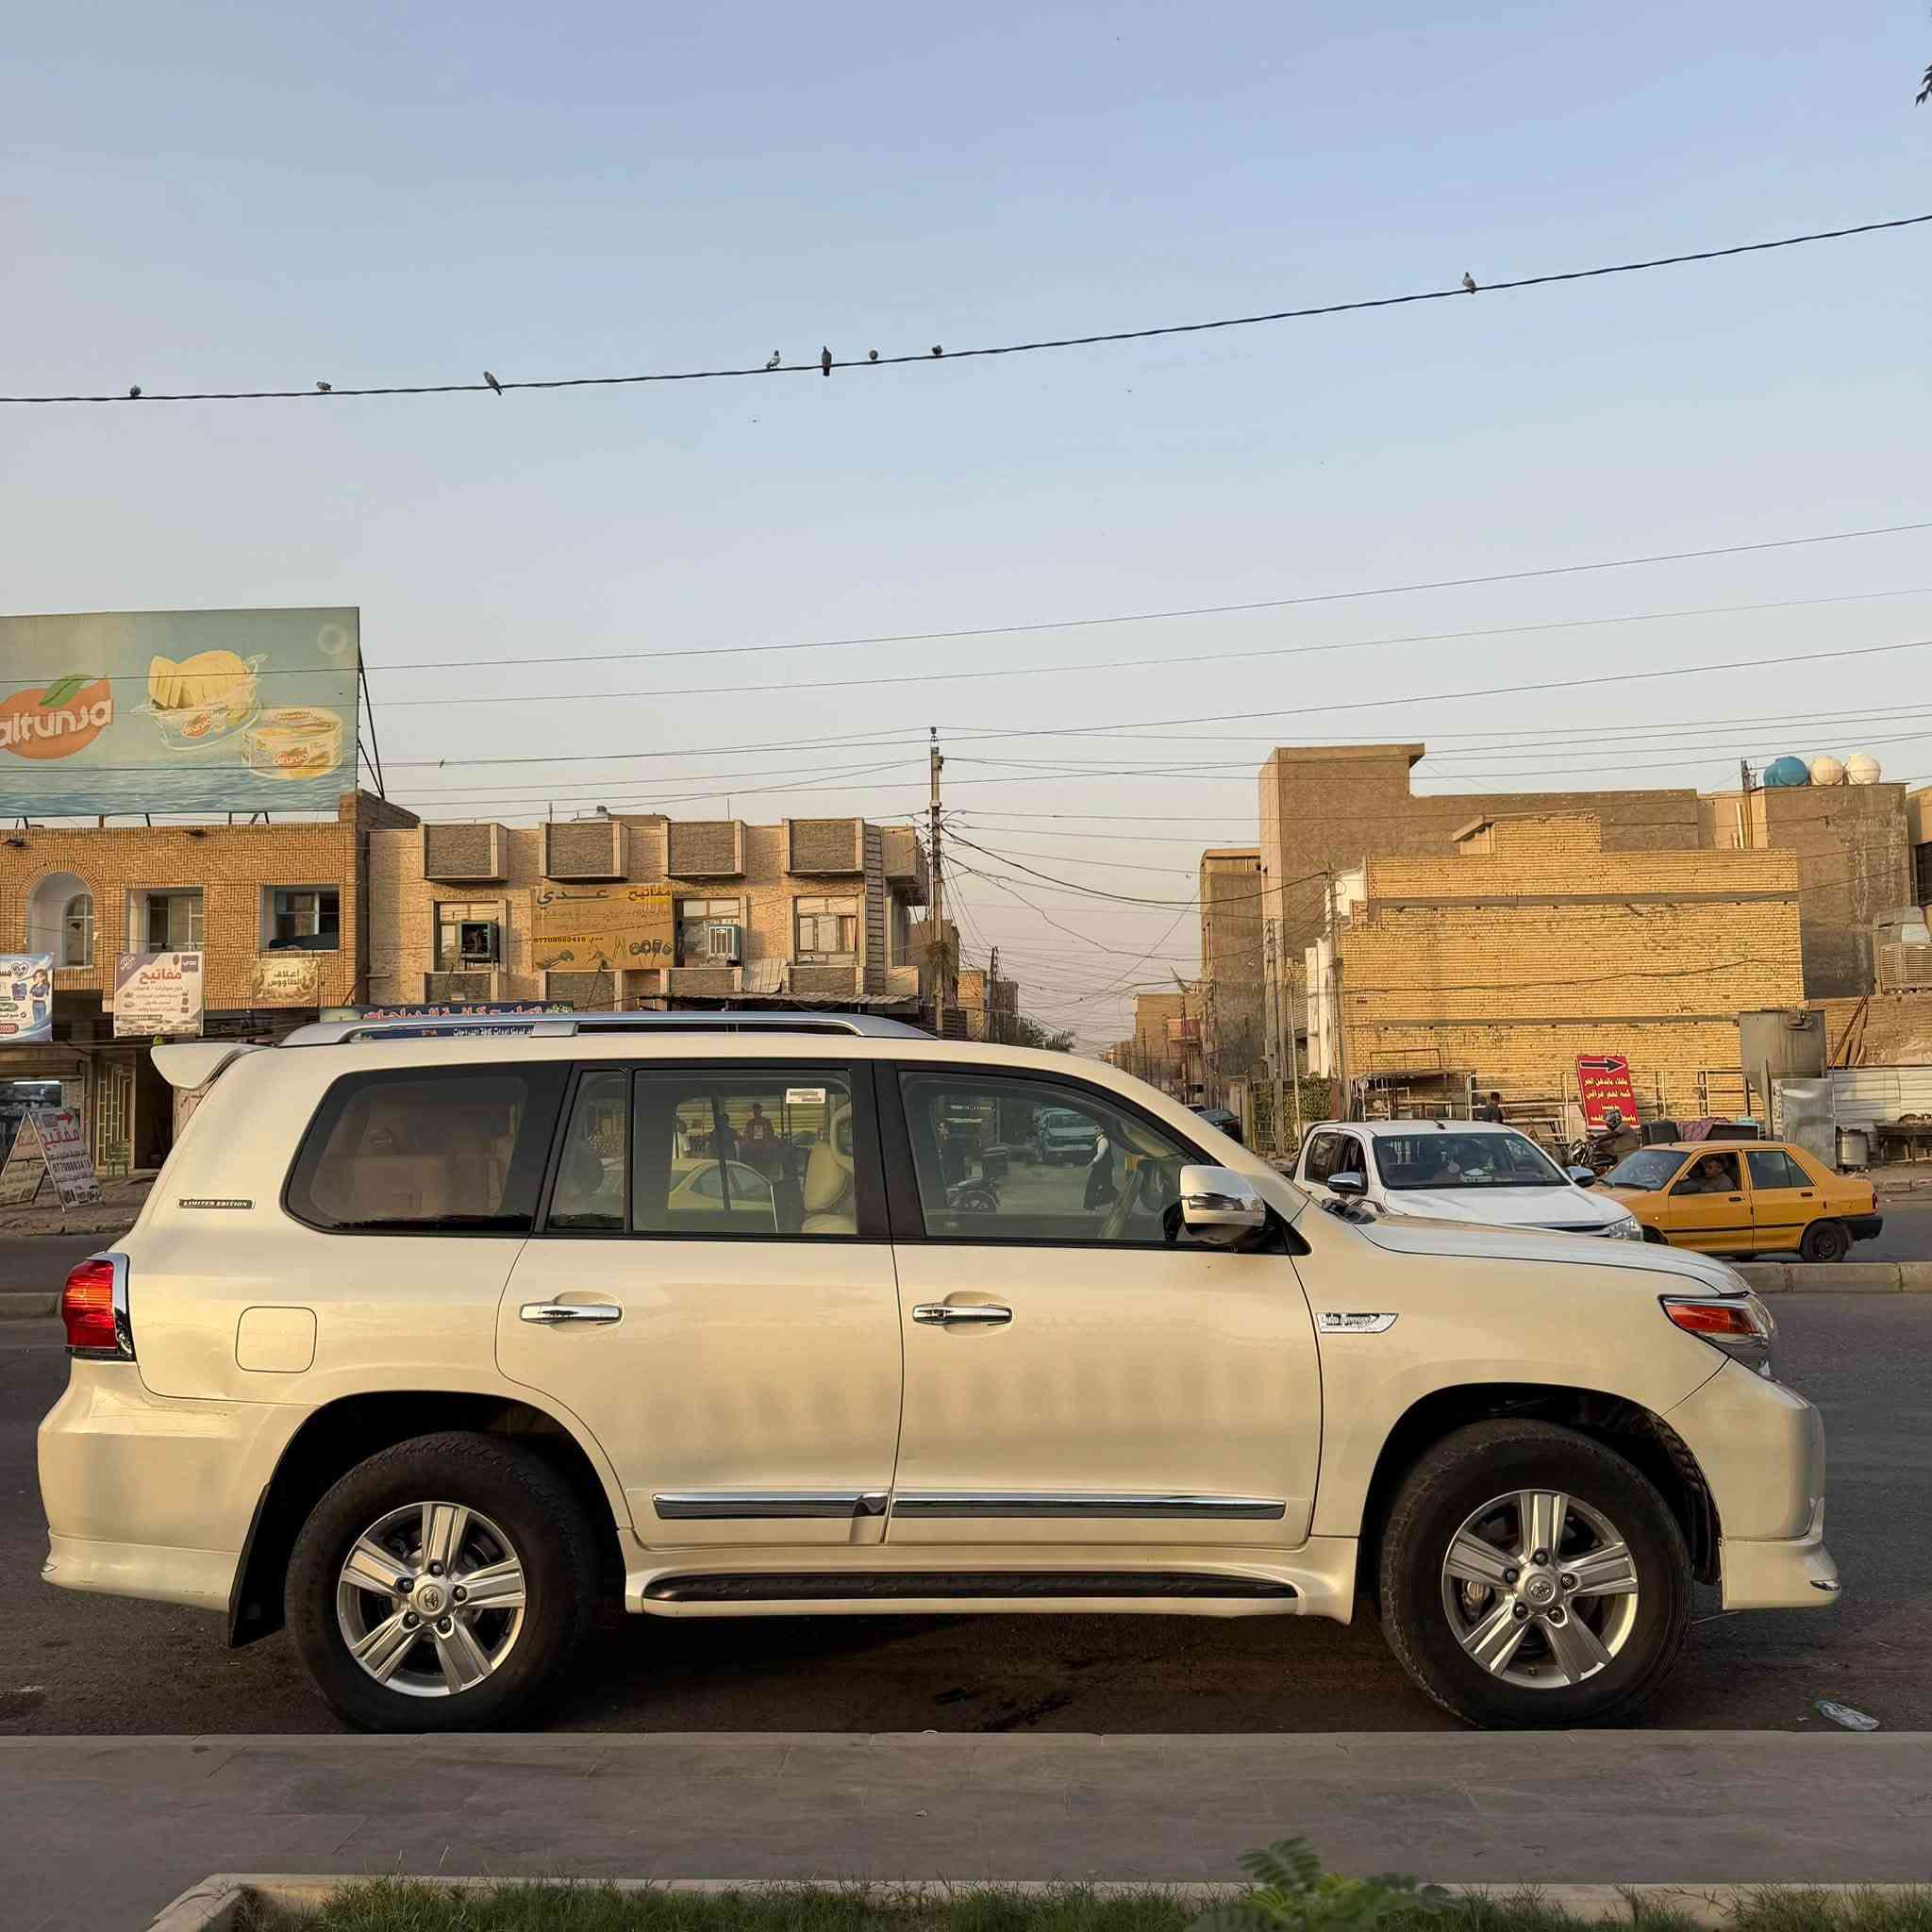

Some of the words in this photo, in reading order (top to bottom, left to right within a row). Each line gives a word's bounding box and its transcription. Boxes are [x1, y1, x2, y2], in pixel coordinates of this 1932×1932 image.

[0, 699, 112, 747] altunsa
[537, 890, 608, 909] عدي
[628, 889, 671, 901] مفاتيح
[139, 967, 182, 985] مفاتيح
